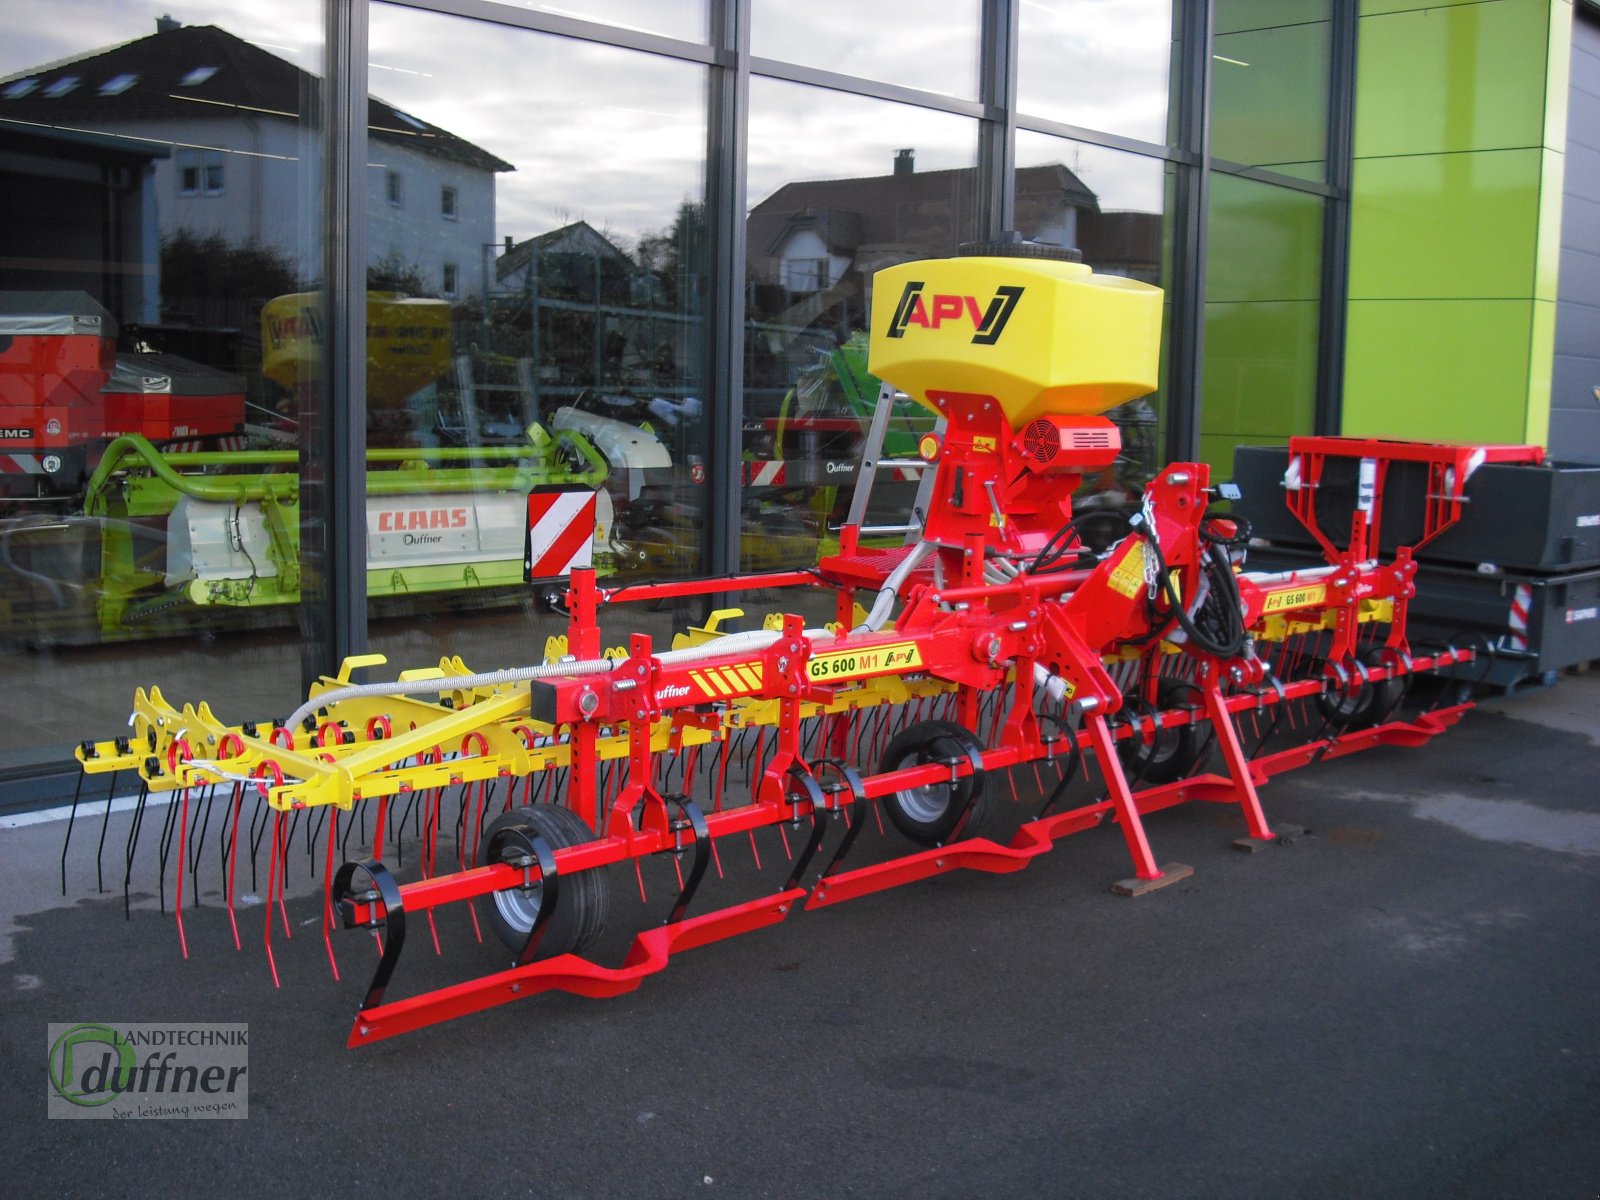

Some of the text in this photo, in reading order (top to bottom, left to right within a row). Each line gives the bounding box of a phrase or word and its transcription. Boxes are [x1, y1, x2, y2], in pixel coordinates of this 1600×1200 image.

[826, 461, 855, 473] Duffner
[378, 509, 467, 532] CLAAS
[403, 533, 442, 545] Duffner
[811, 661, 829, 677] GS
[832, 657, 856, 674] 600
[859, 654, 878, 670] M1
[657, 685, 691, 699] uffner
